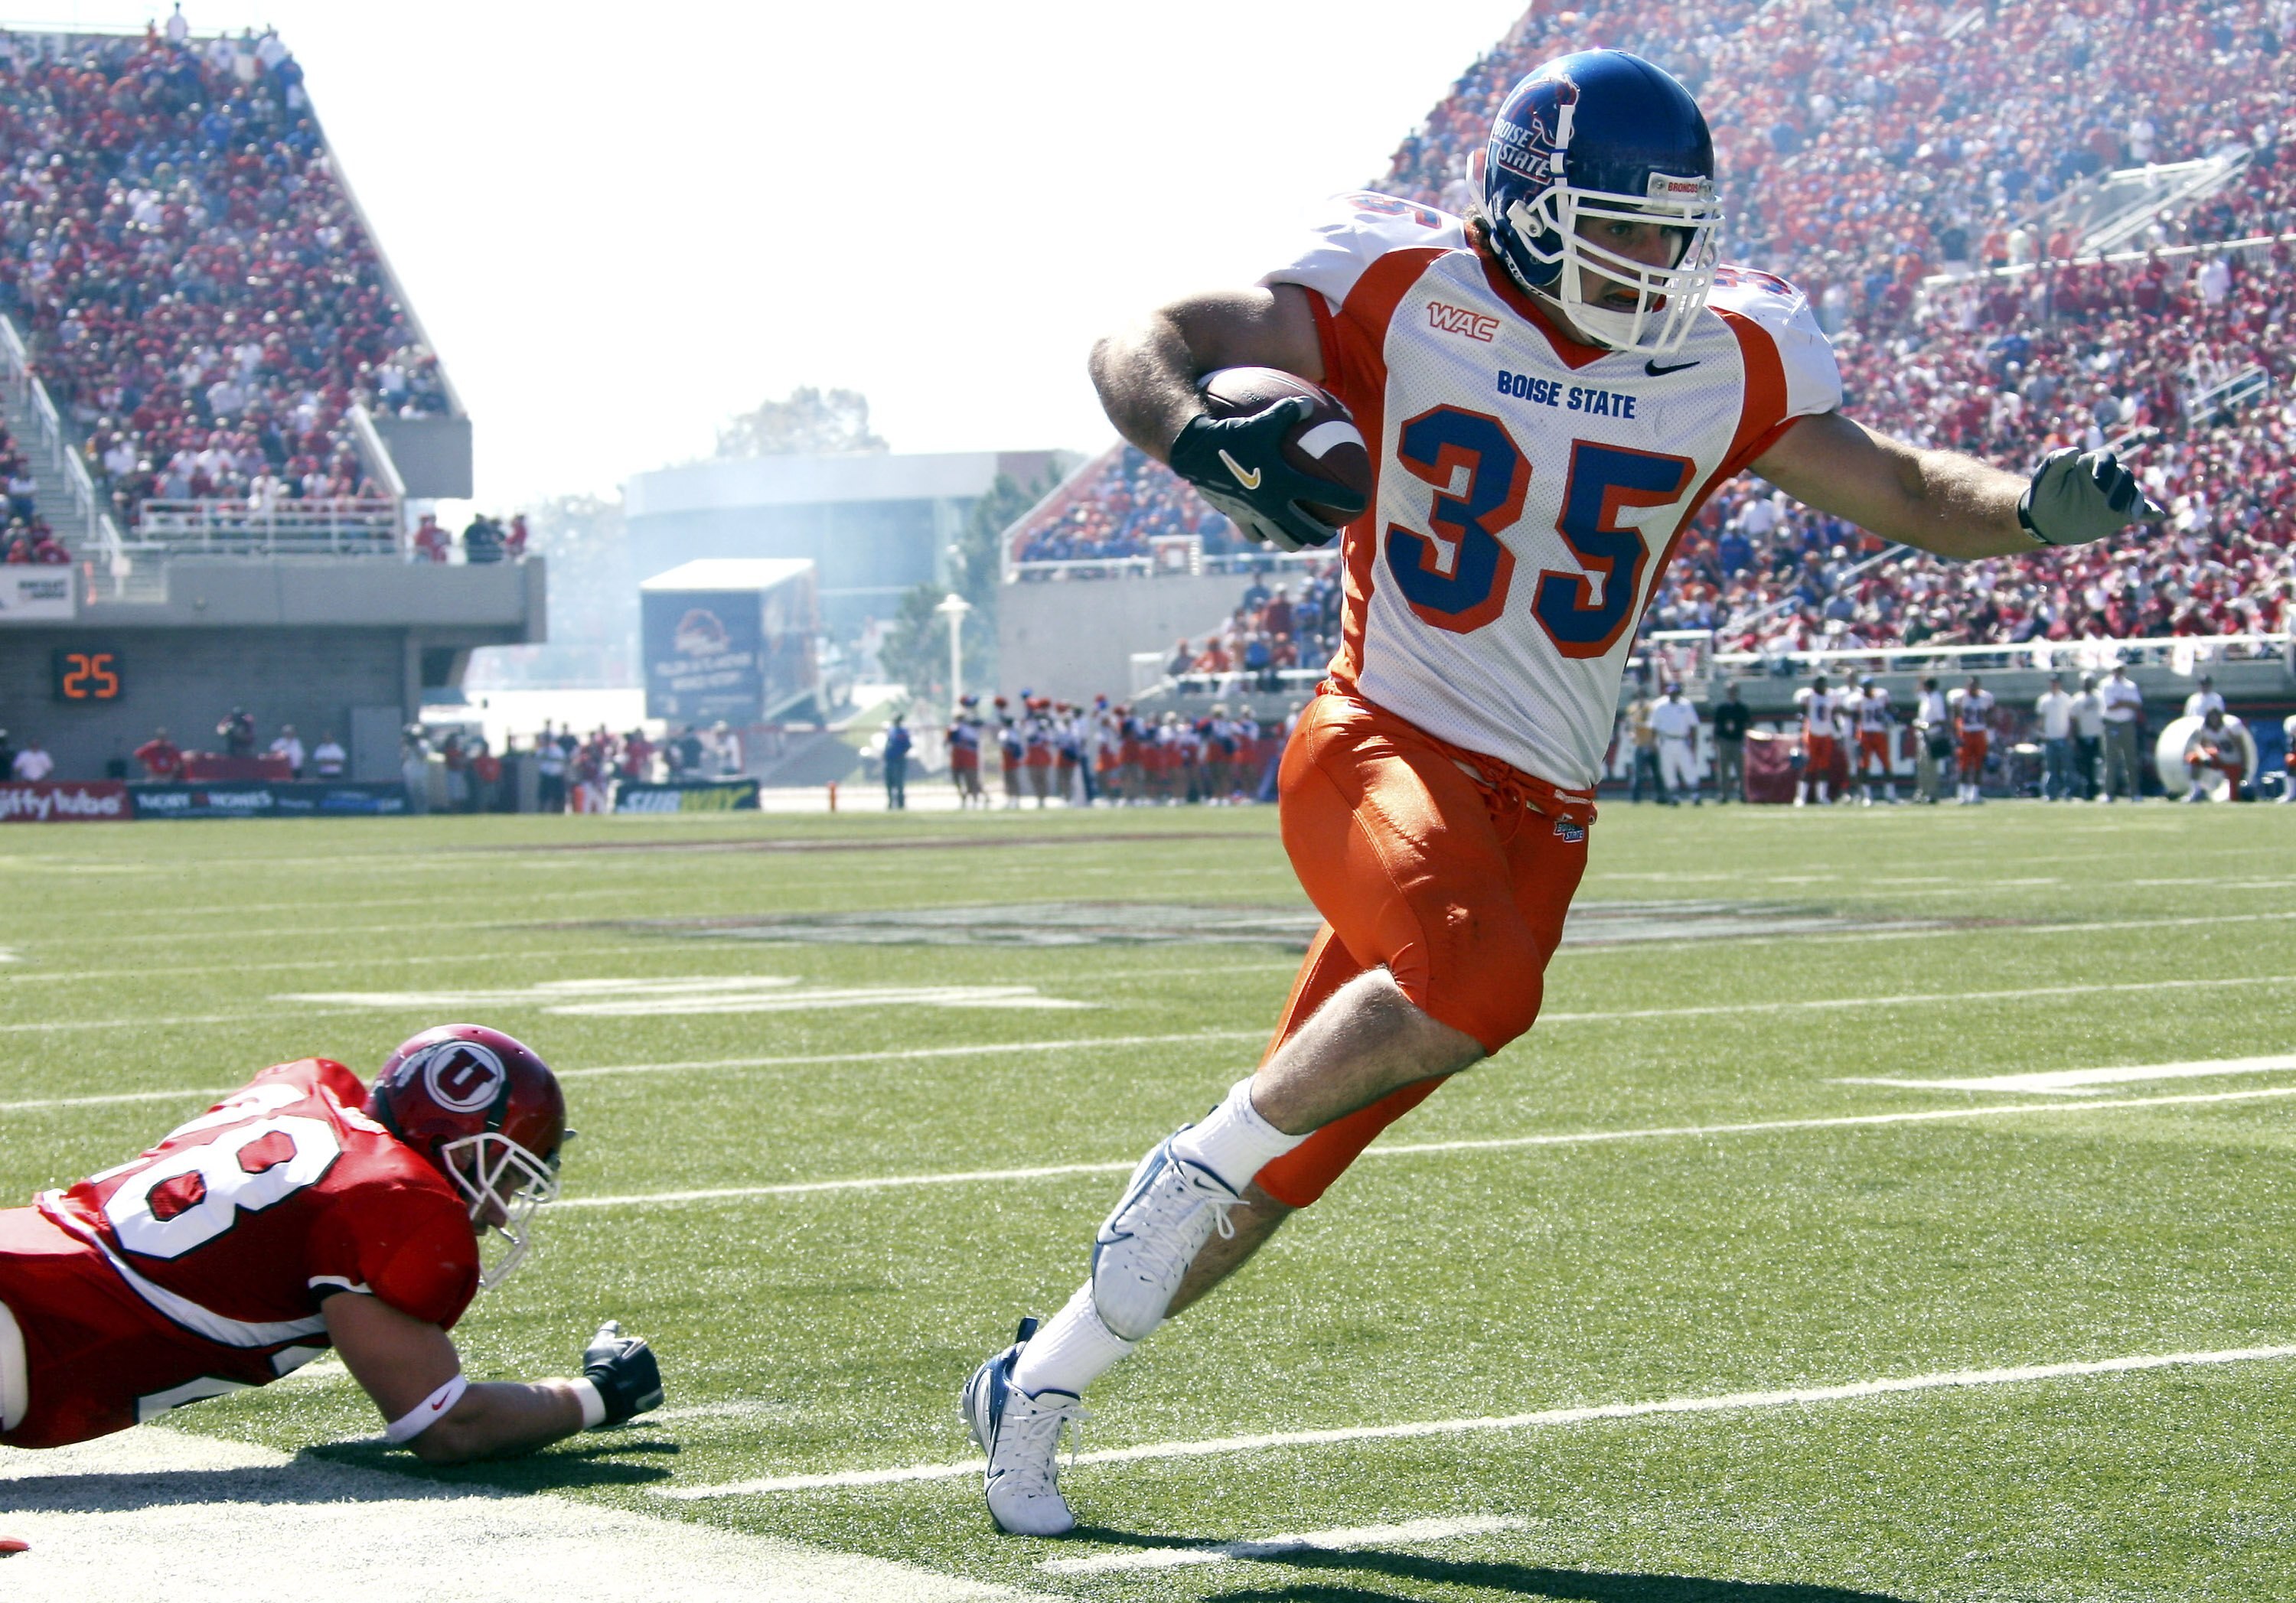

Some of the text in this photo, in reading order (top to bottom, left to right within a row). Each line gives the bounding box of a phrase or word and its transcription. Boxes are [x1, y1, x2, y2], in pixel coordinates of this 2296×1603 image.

[1495, 119, 1533, 148] BOISE
[1499, 144, 1551, 178] STATE
[1668, 181, 1698, 193] BRONCOS
[1427, 301, 1500, 342] WAC
[1497, 370, 1636, 419] BOISE STATE
[1384, 403, 1697, 660] 35
[63, 653, 119, 699] 25
[617, 787, 754, 814] SUBWAY
[437, 1047, 497, 1102] U
